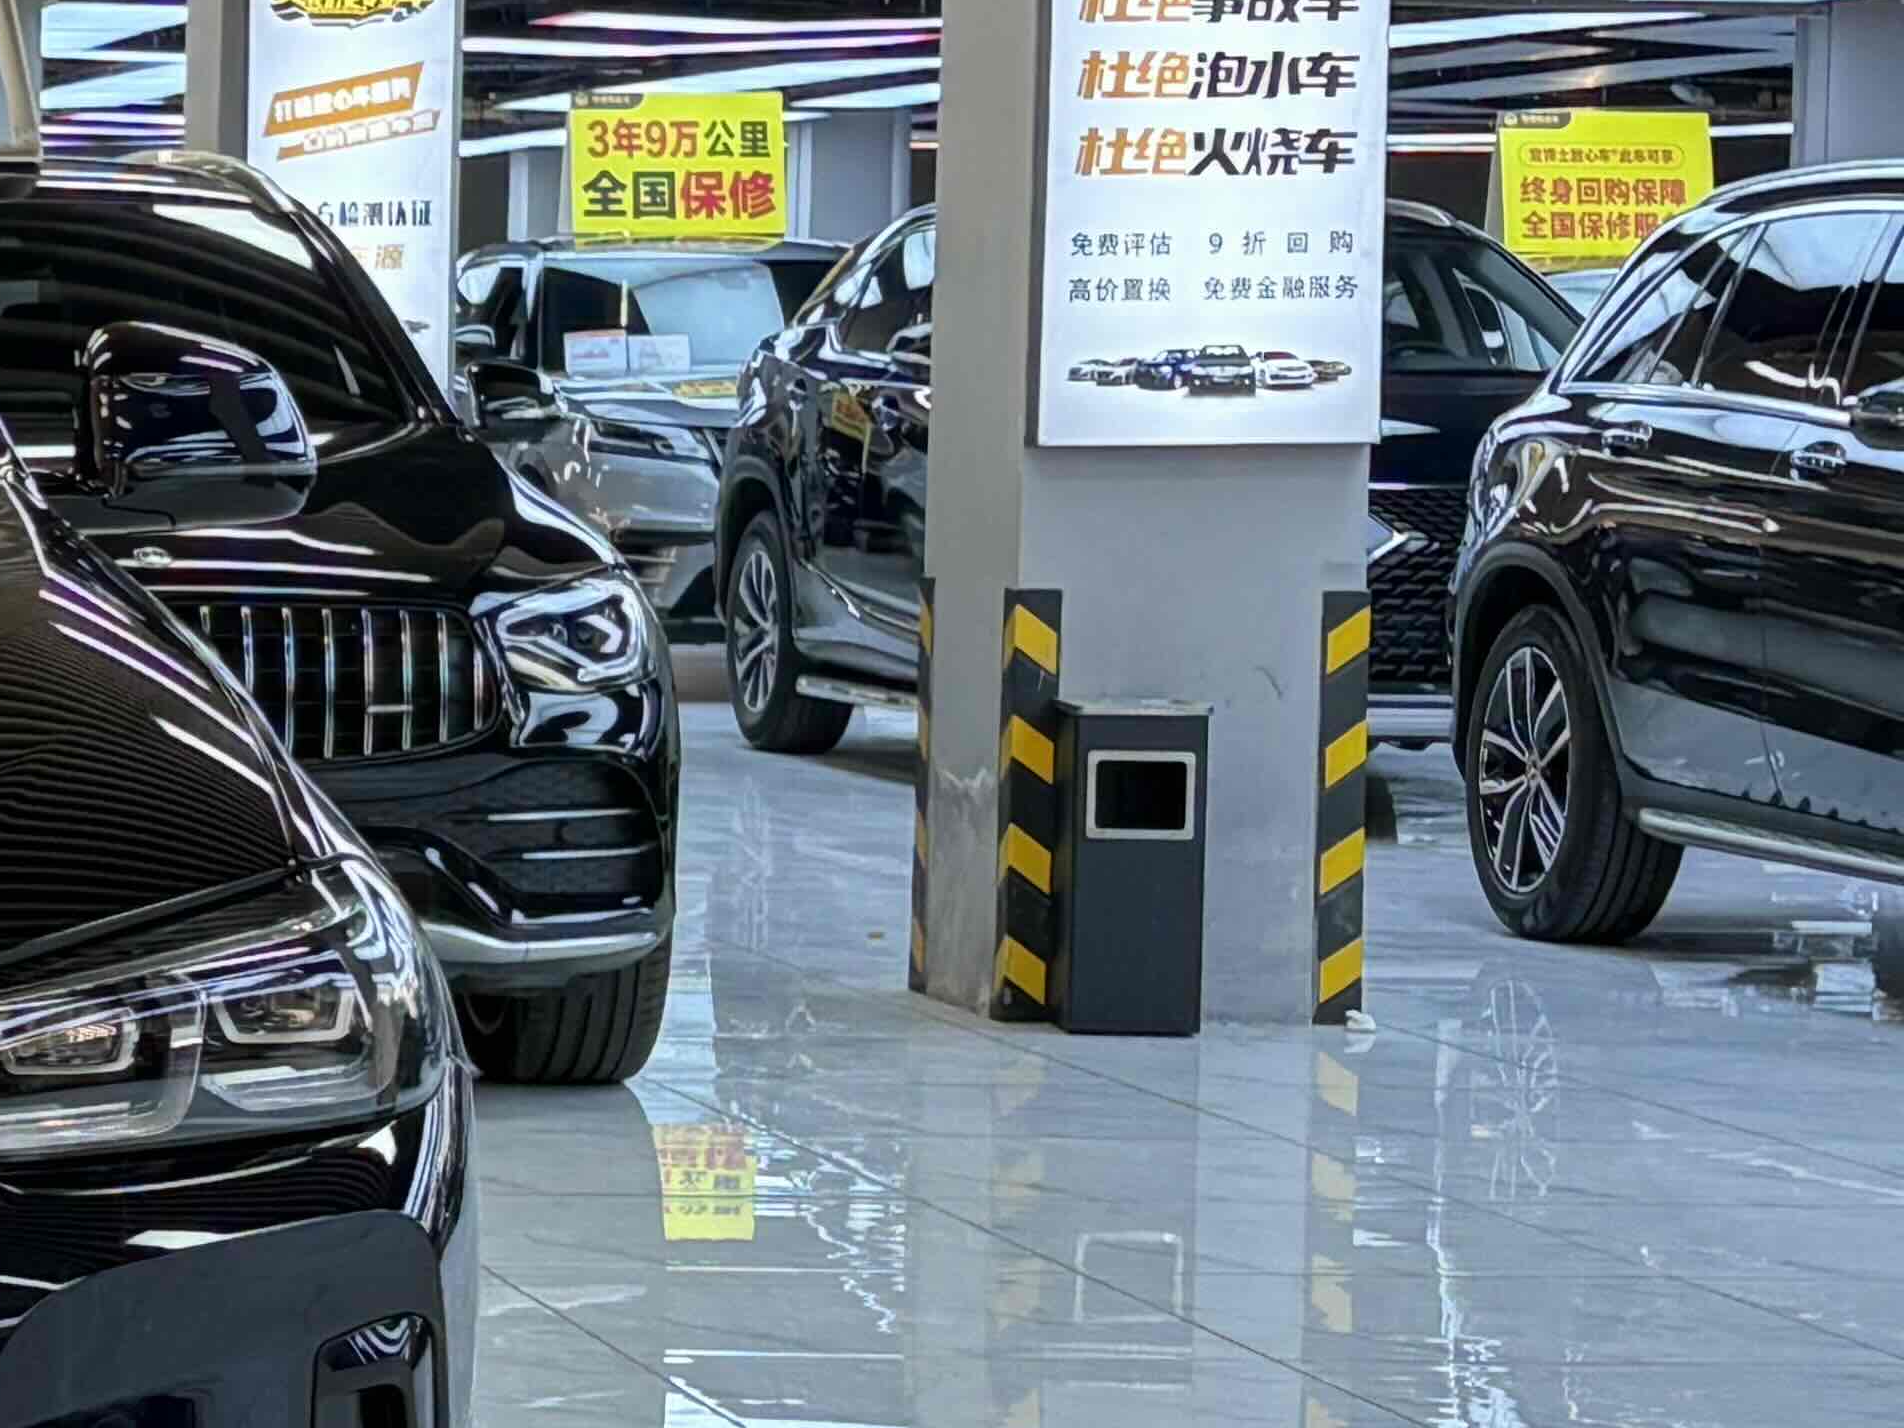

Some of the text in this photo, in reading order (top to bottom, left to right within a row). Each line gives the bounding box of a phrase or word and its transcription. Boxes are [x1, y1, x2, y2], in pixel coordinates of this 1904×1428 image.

[1077, 51, 1360, 100] 杜绝泡水车
[586, 118, 772, 160] 3年9万公里
[1075, 128, 1358, 177] 杜绝火烧车
[582, 169, 777, 220] 全国保修
[1520, 177, 1687, 207] 终身回购保障
[1069, 231, 1173, 257] 免费评估
[1522, 211, 1673, 241] 全国保修服
[1068, 276, 1360, 302] 高价置换 免费金融服务
